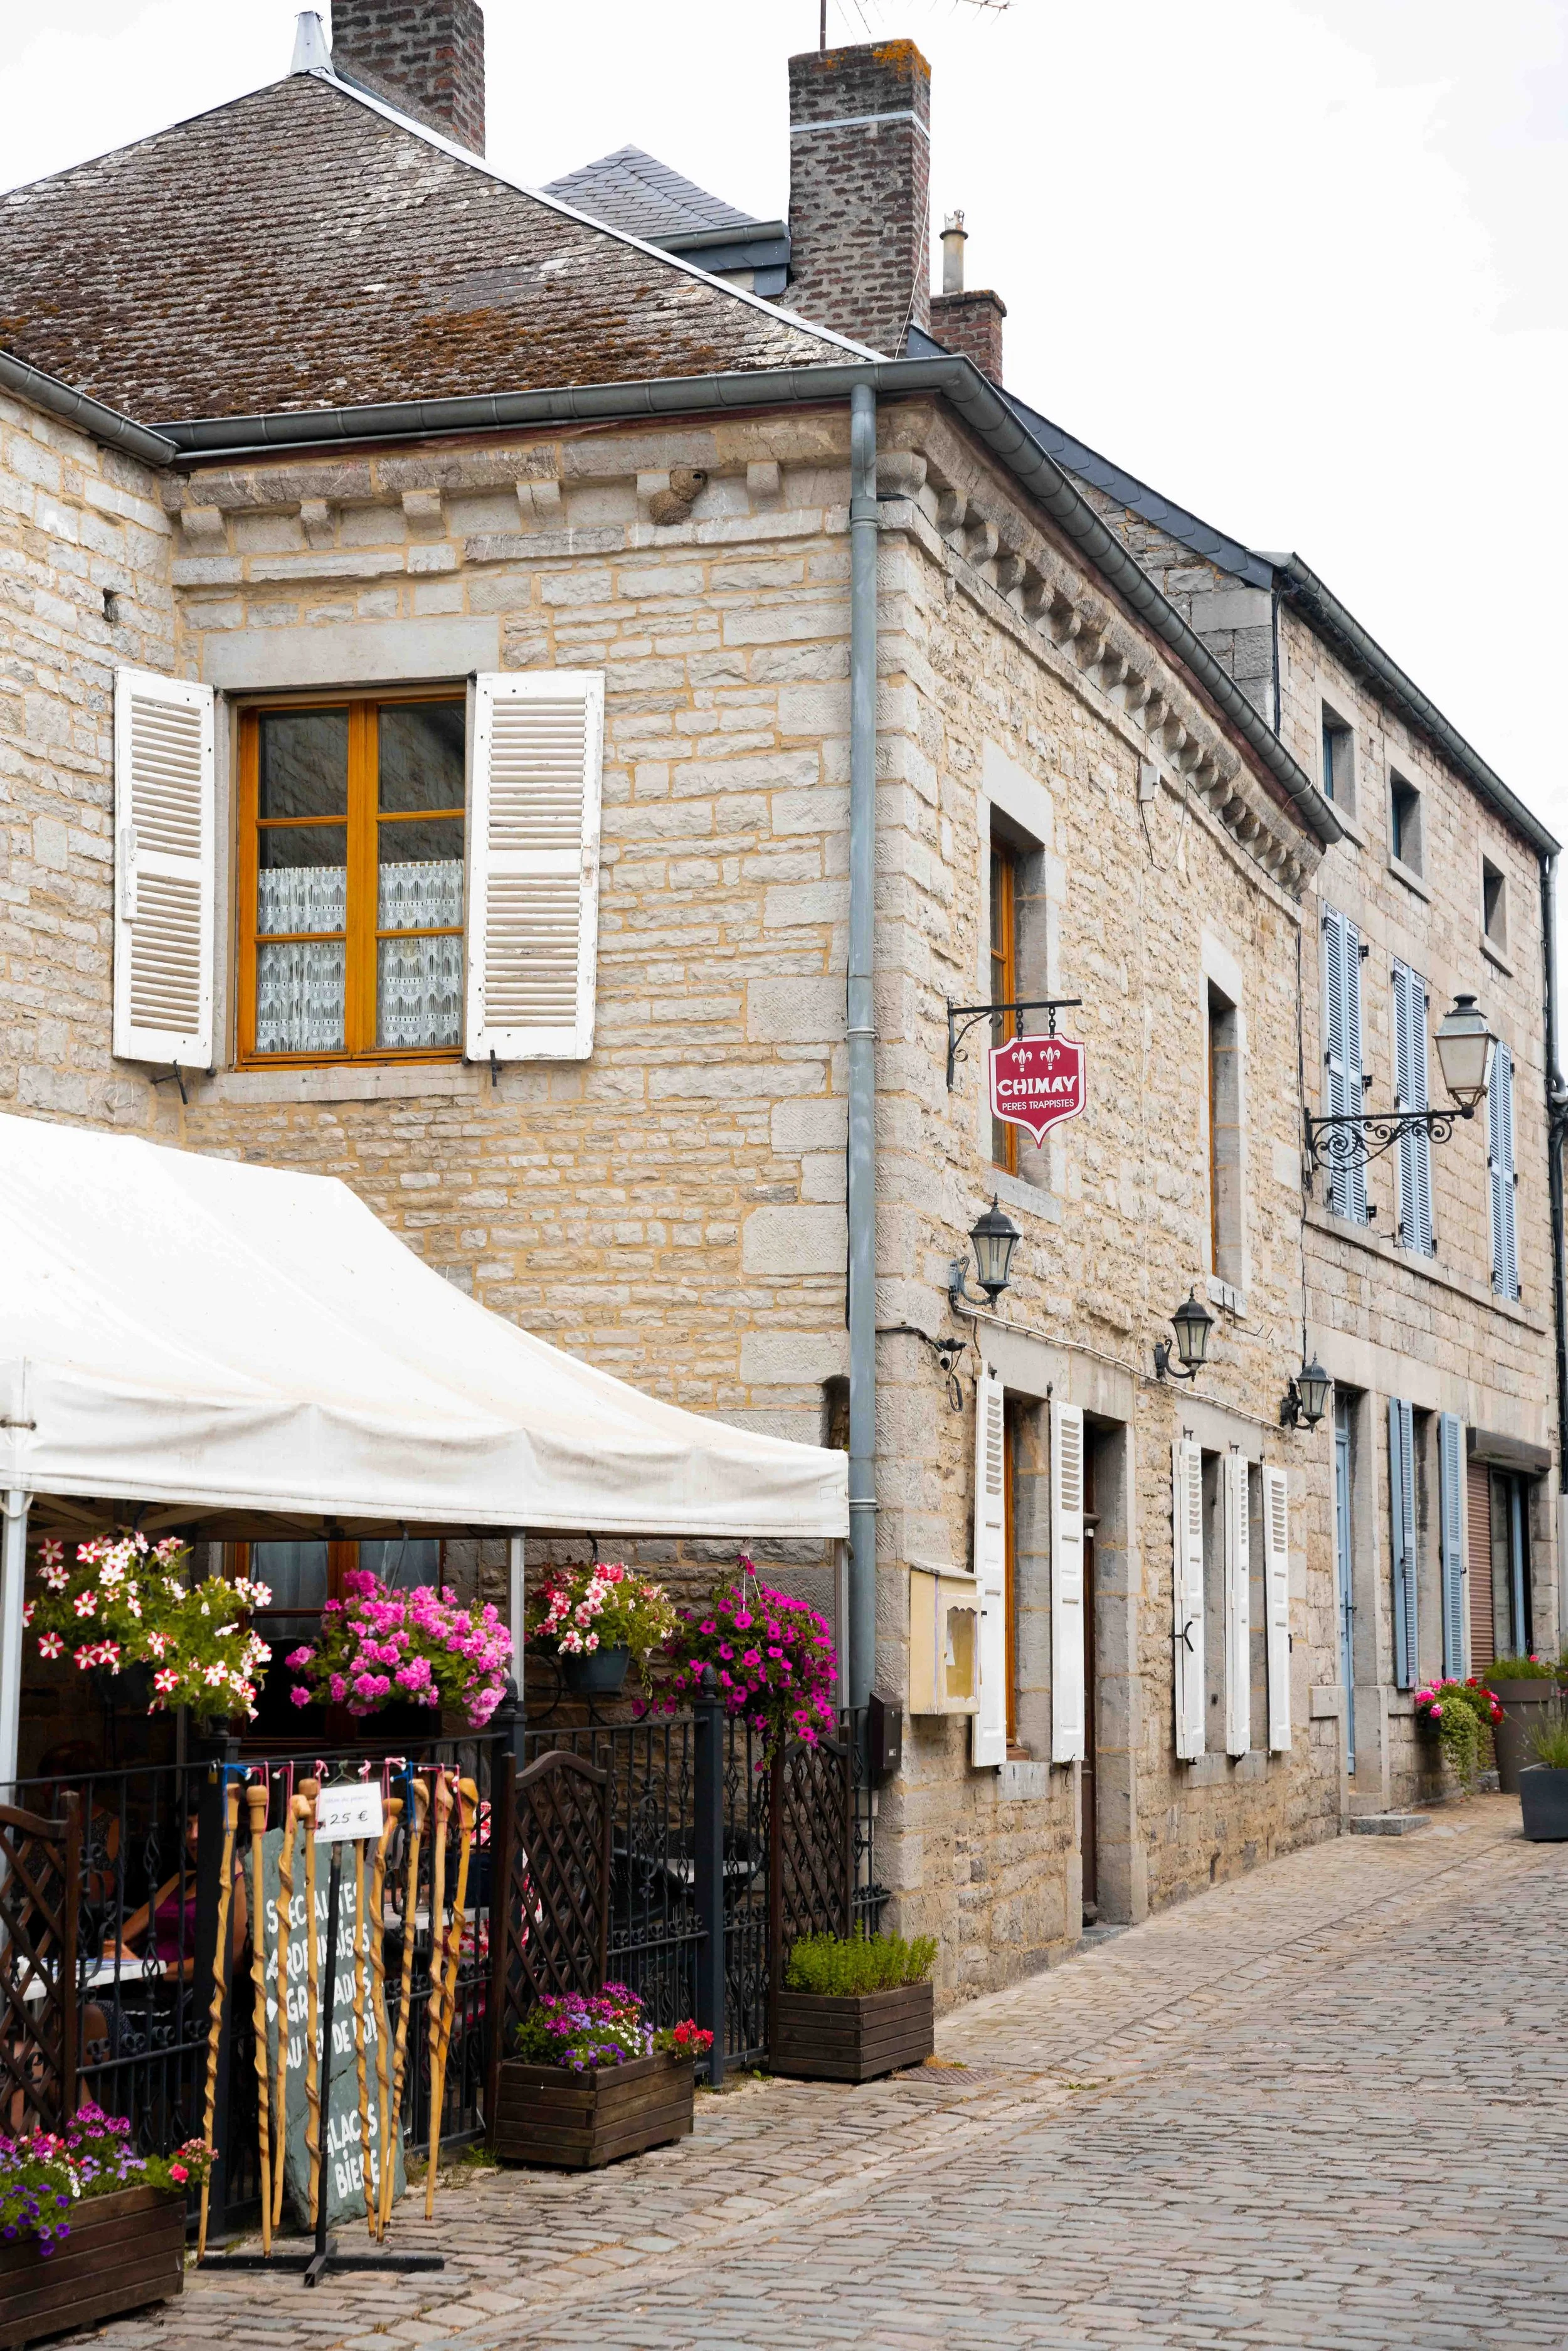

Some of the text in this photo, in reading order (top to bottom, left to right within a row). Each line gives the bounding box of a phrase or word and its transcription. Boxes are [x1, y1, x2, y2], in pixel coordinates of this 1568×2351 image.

[997, 1075, 1078, 1096] CHIMAY
[1002, 1098, 1075, 1111] PERES TRAPPISTES
[330, 1810, 368, 1825] 25 €
[286, 1966, 371, 2024] GRLADS
[332, 2019, 352, 2055] DE
[327, 2103, 378, 2158] LACS
